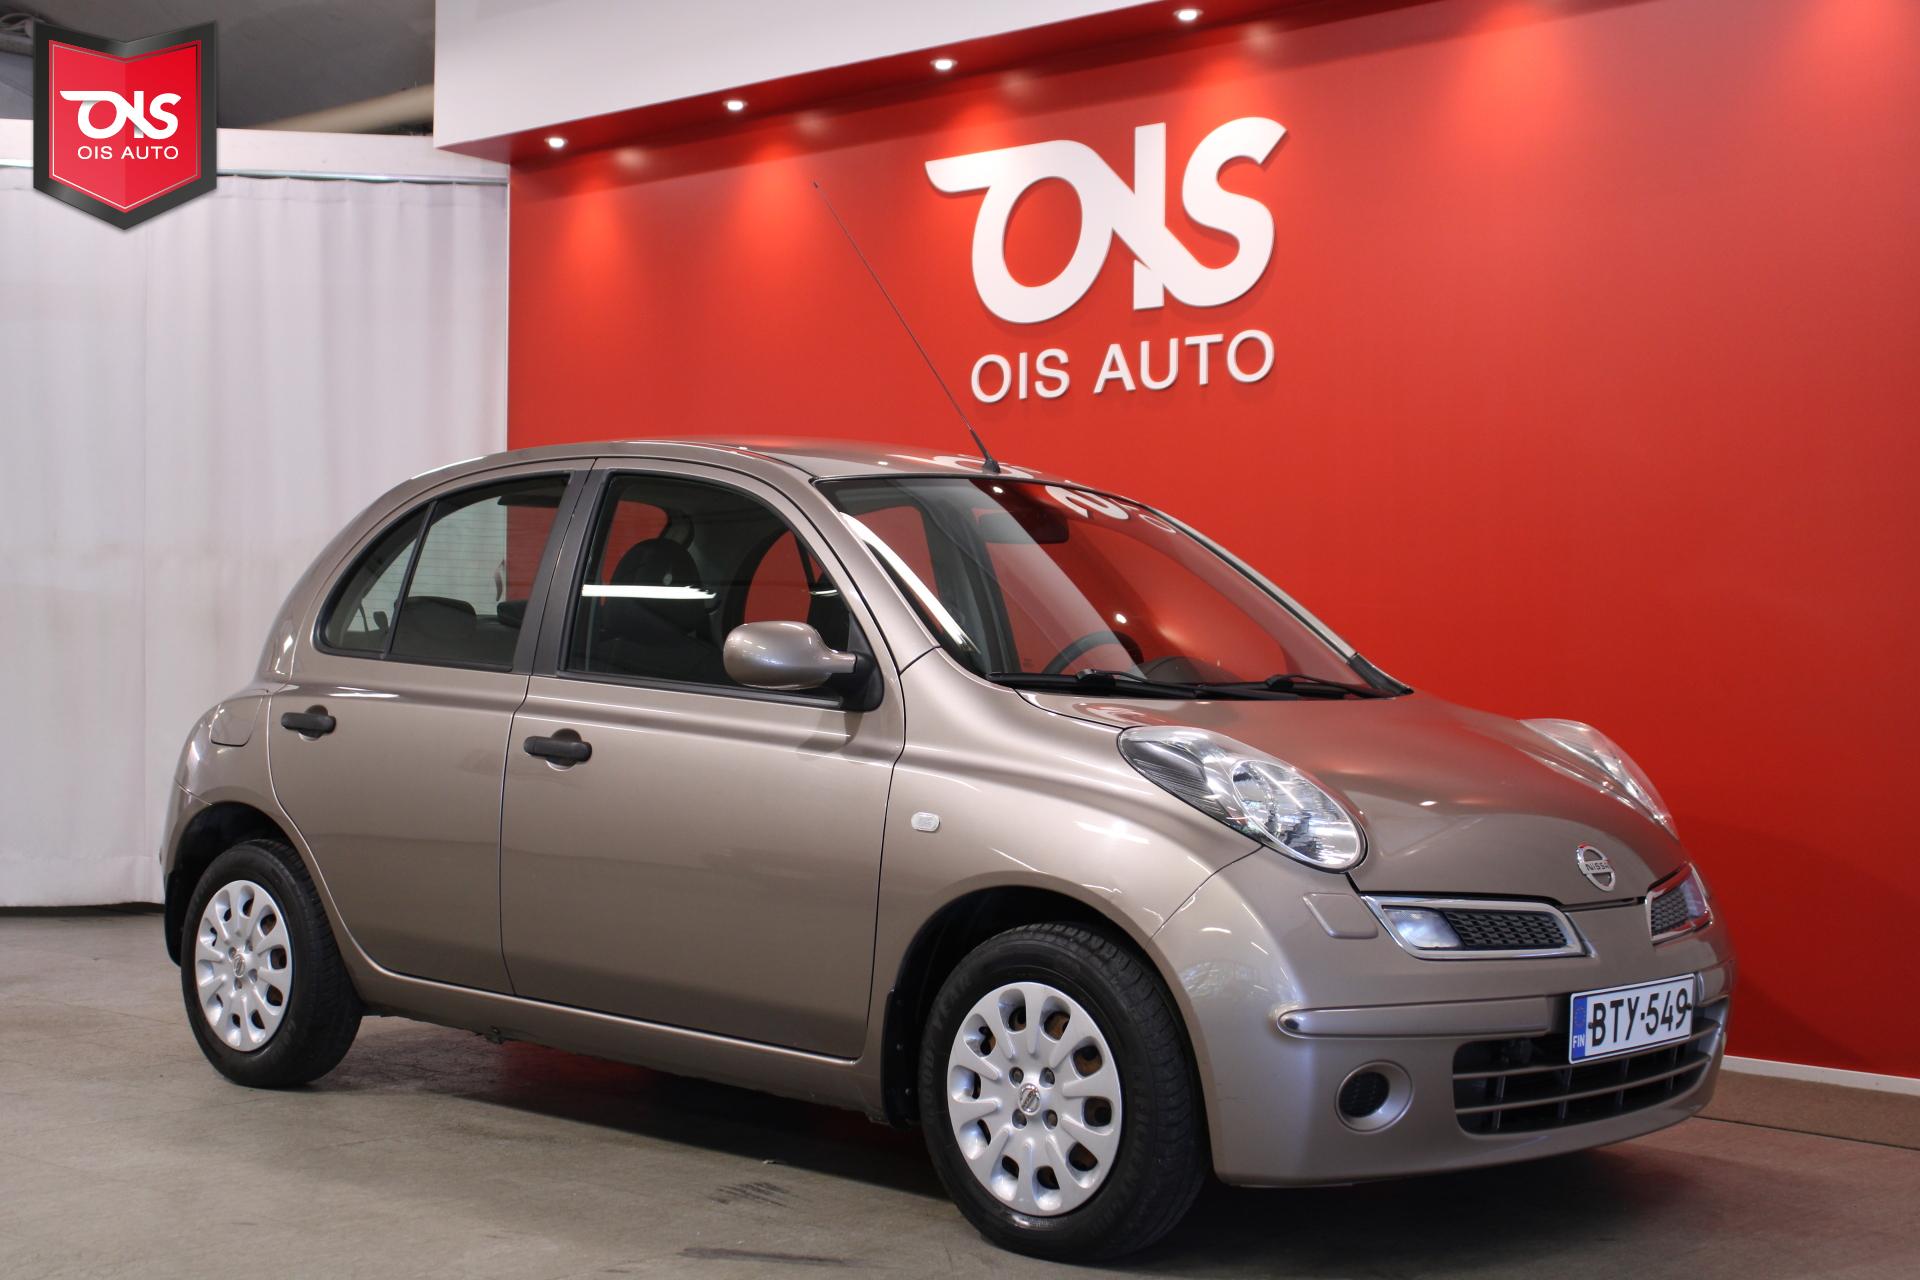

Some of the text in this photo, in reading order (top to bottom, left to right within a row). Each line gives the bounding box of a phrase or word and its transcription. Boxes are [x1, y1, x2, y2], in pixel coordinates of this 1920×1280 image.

[971, 329, 1275, 403] OIS AUTO
[1572, 1034, 1586, 1048] FIN
[1591, 988, 1689, 1046] BTY-549
